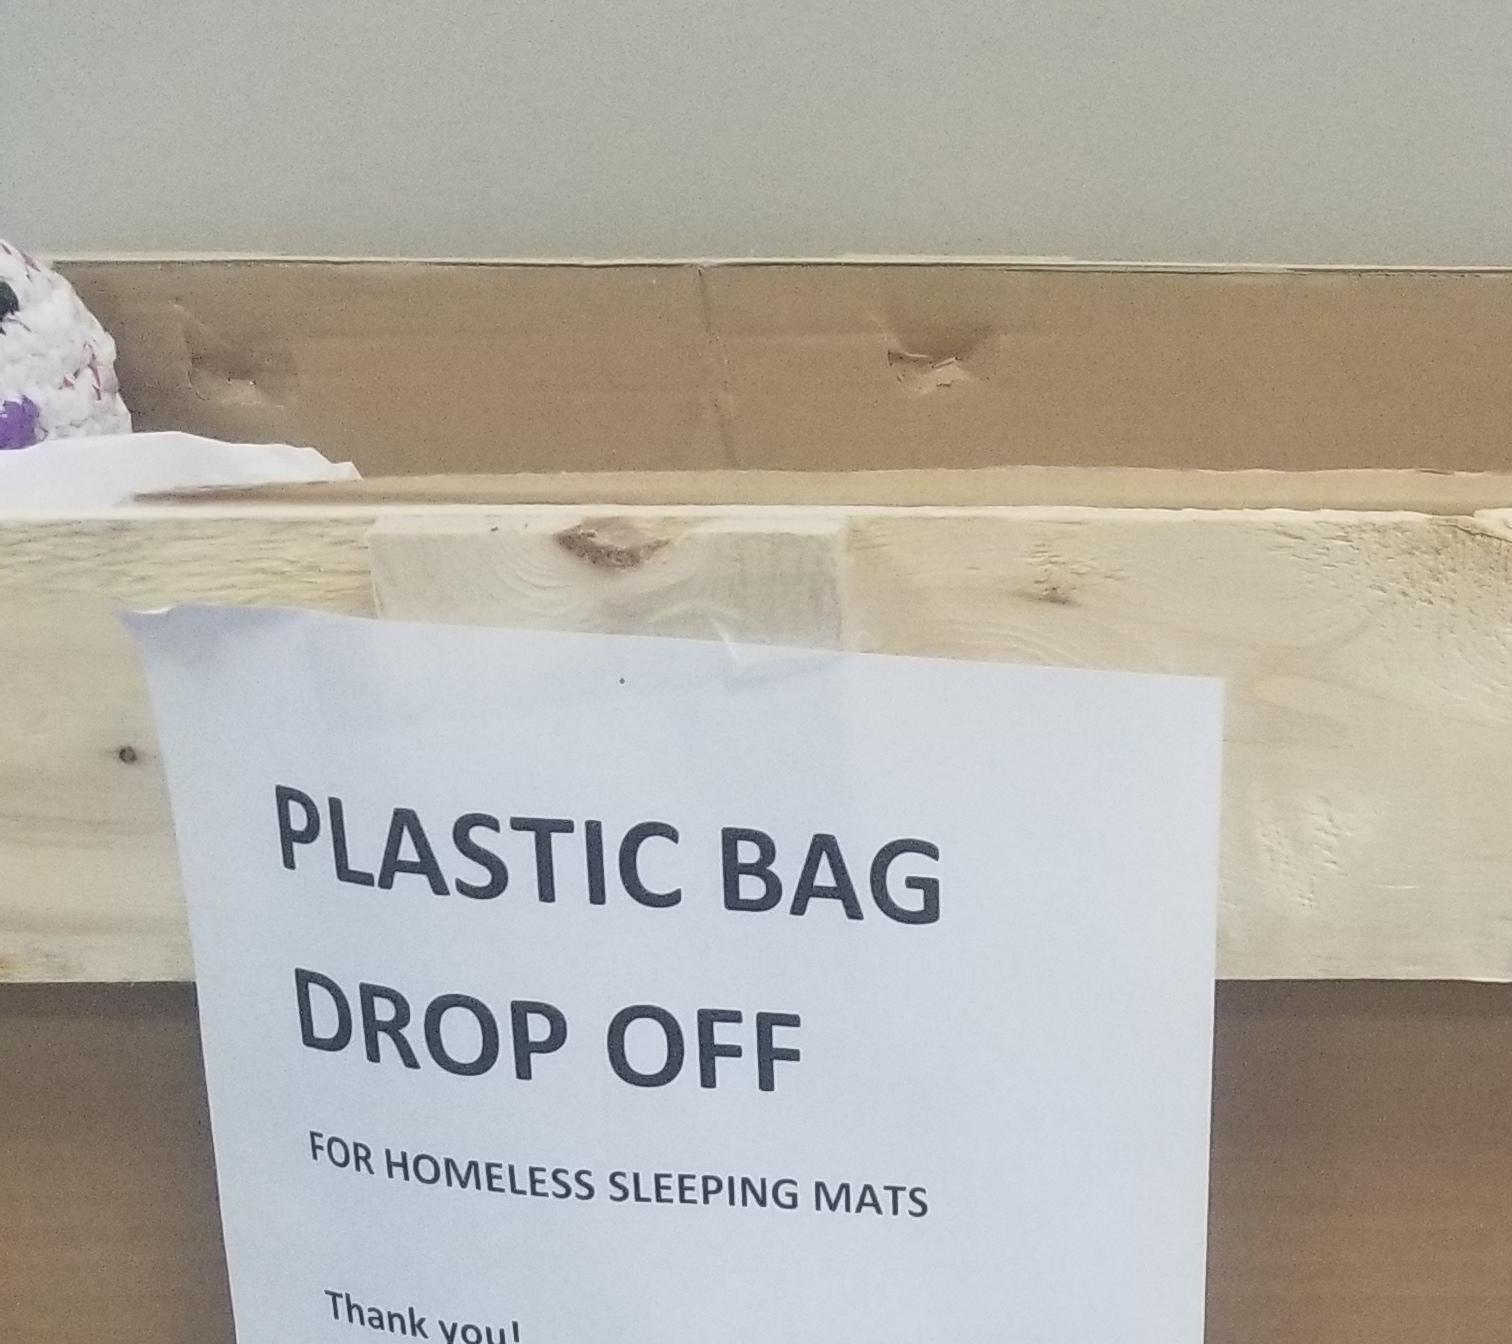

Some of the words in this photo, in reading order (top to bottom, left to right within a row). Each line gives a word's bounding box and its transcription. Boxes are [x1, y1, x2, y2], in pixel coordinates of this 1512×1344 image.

[274, 784, 683, 909] PLASTIC
[720, 826, 941, 926] BAG
[294, 967, 568, 1081] DROP
[606, 1004, 802, 1093] OFF
[309, 1130, 375, 1176] FOR
[384, 1148, 596, 1201] HOMELESS
[608, 1170, 799, 1210] SLEEPING
[814, 1180, 929, 1218] MATS
[323, 1289, 429, 1340] Thank
